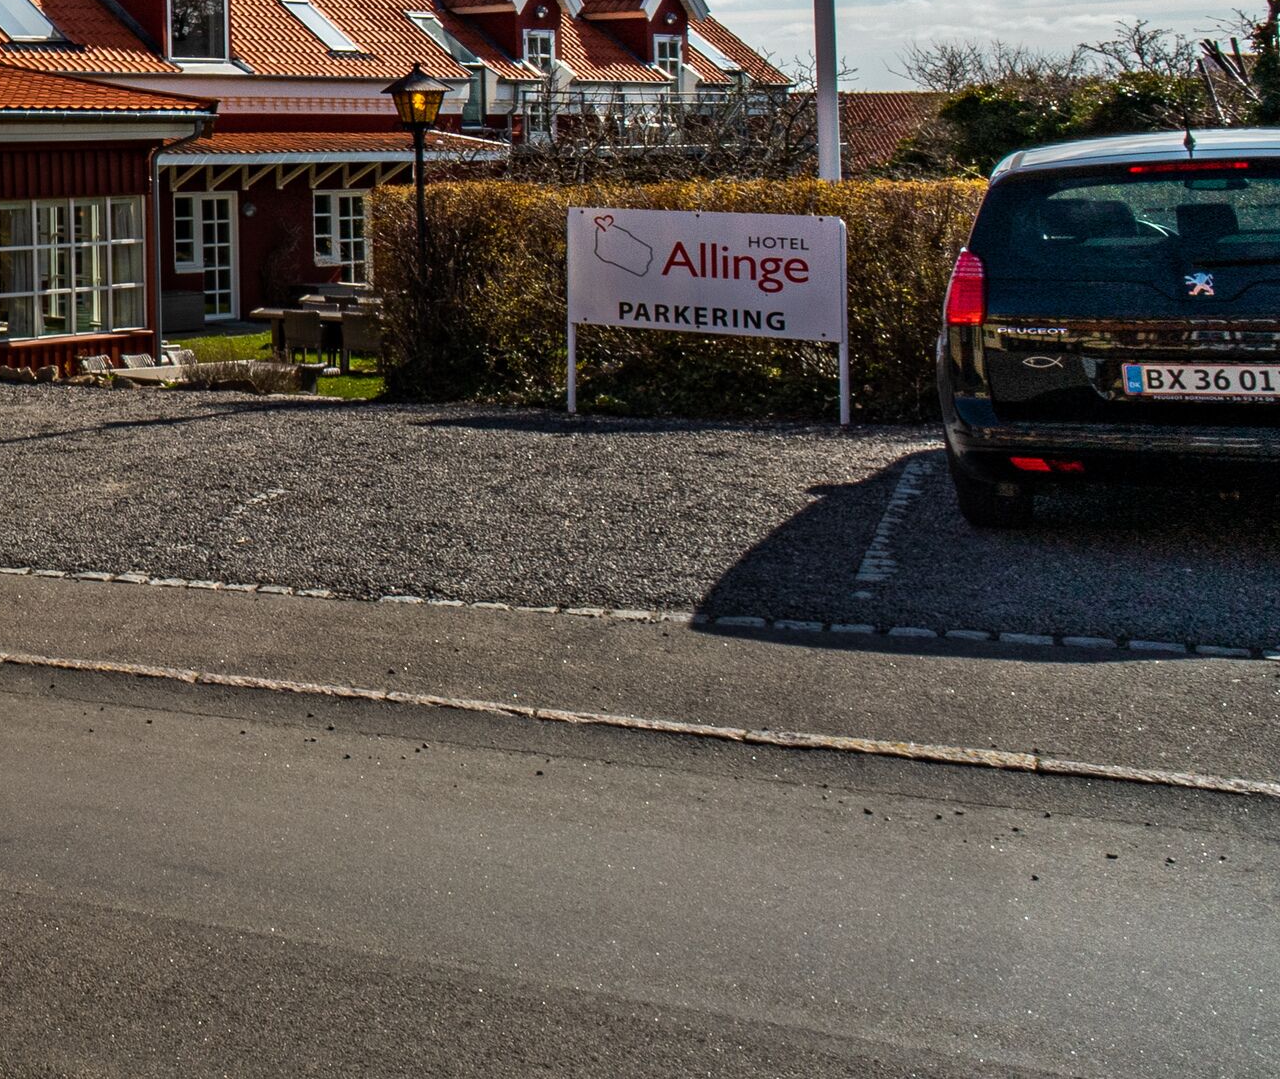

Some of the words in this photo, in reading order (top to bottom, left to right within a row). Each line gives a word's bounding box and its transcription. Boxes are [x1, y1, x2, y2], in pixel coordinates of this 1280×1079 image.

[748, 236, 809, 251] HOTEL
[662, 241, 809, 293] Allinge
[618, 302, 786, 331] PARKERING
[997, 327, 1068, 335] PEUGEOT
[1146, 369, 1187, 390] BX
[1194, 369, 1231, 391] 36
